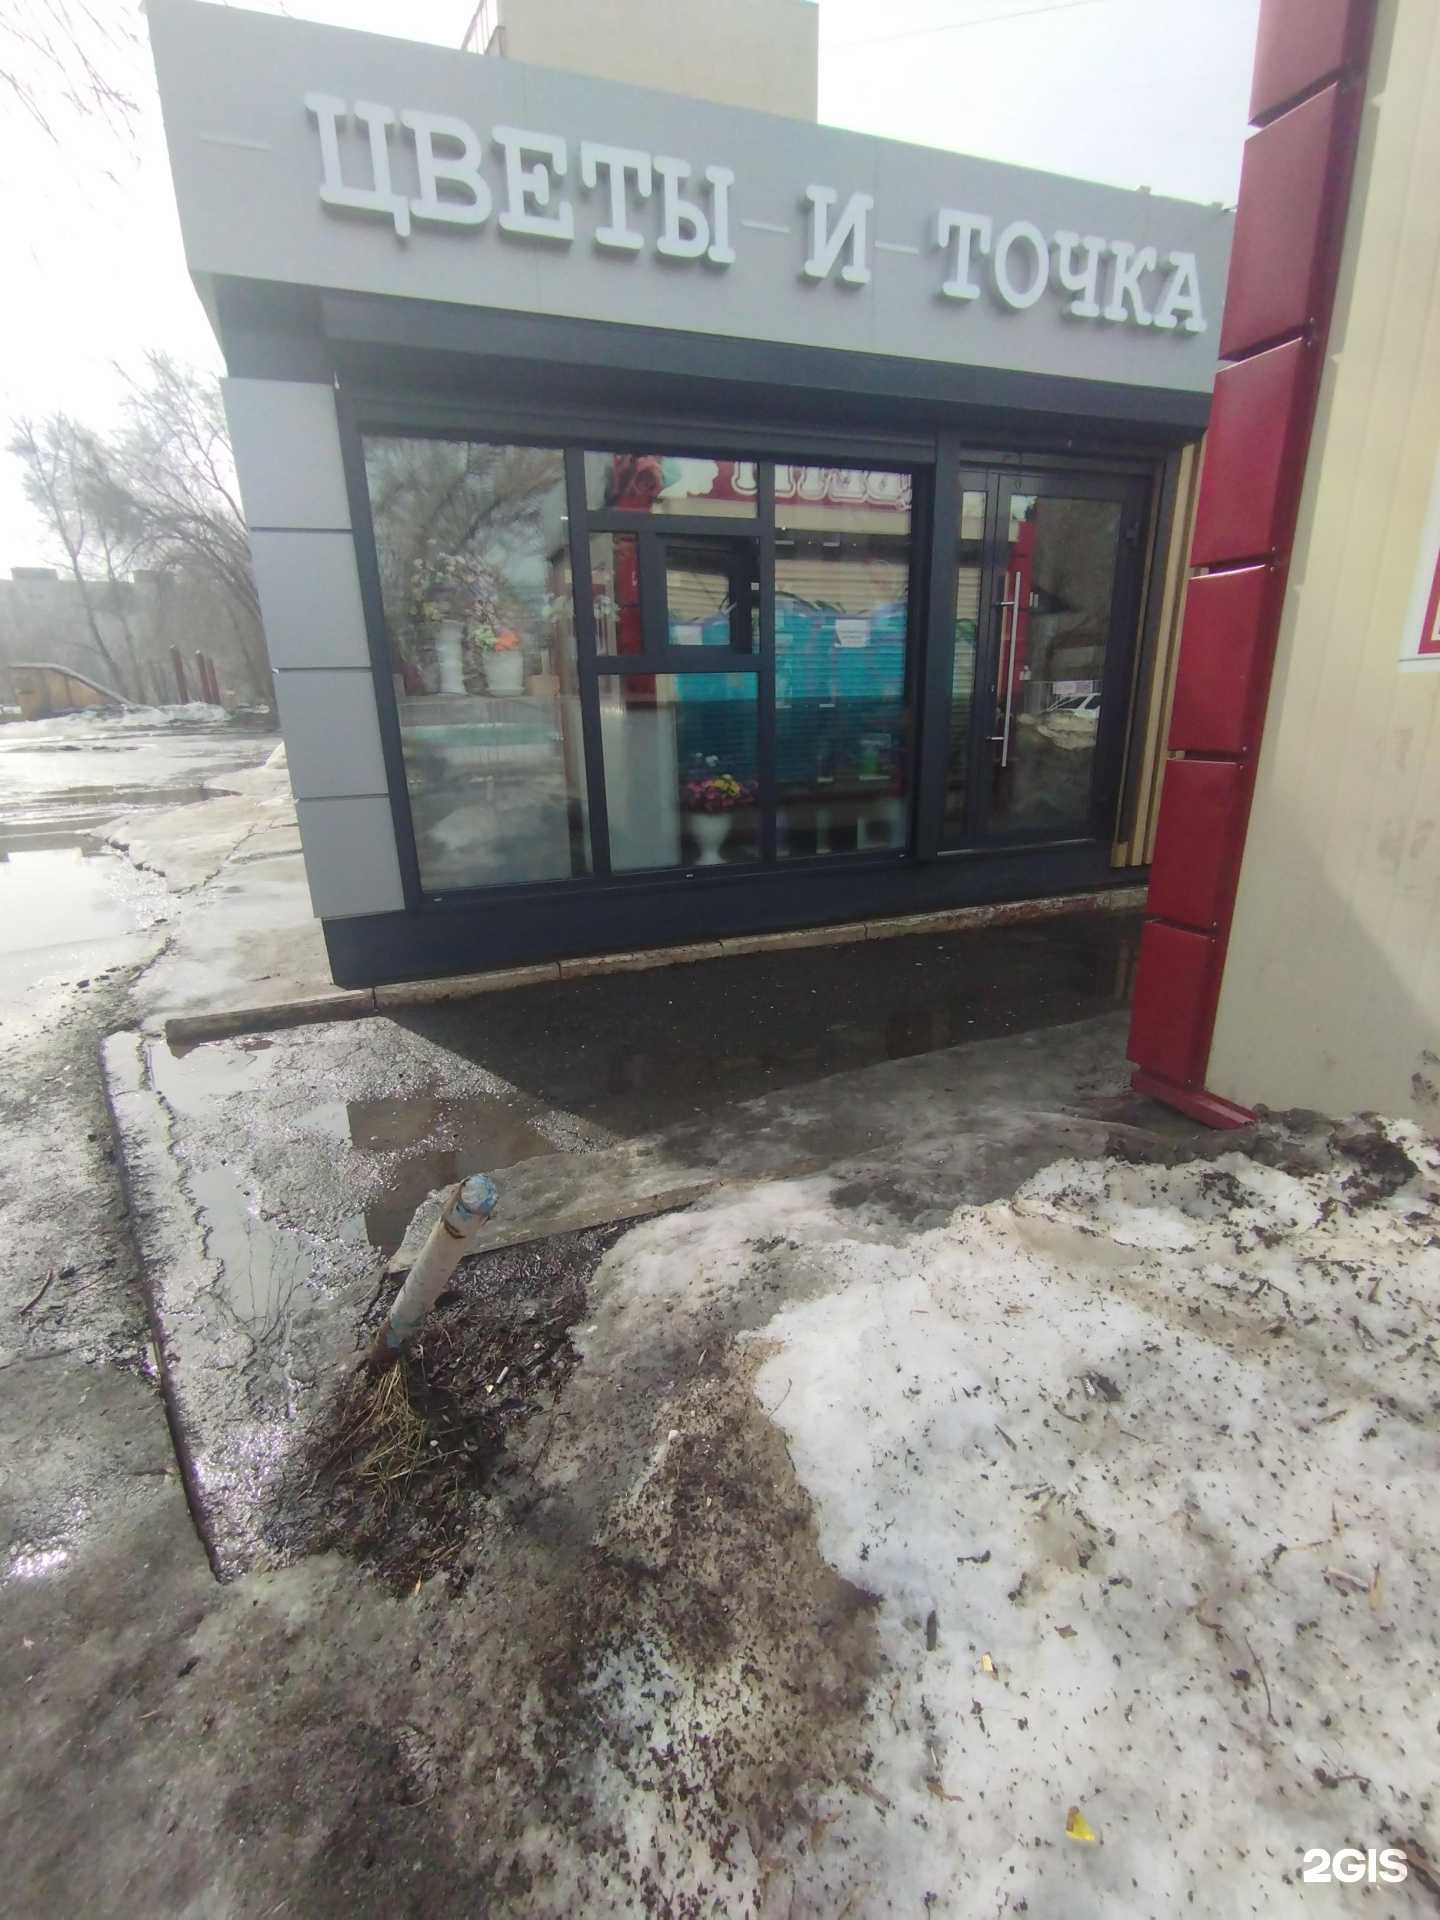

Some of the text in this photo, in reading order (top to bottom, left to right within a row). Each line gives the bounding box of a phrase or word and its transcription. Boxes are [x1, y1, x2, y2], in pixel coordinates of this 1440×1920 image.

[305, 92, 1207, 332] ЦВЕТЫ И ТОЧКА
